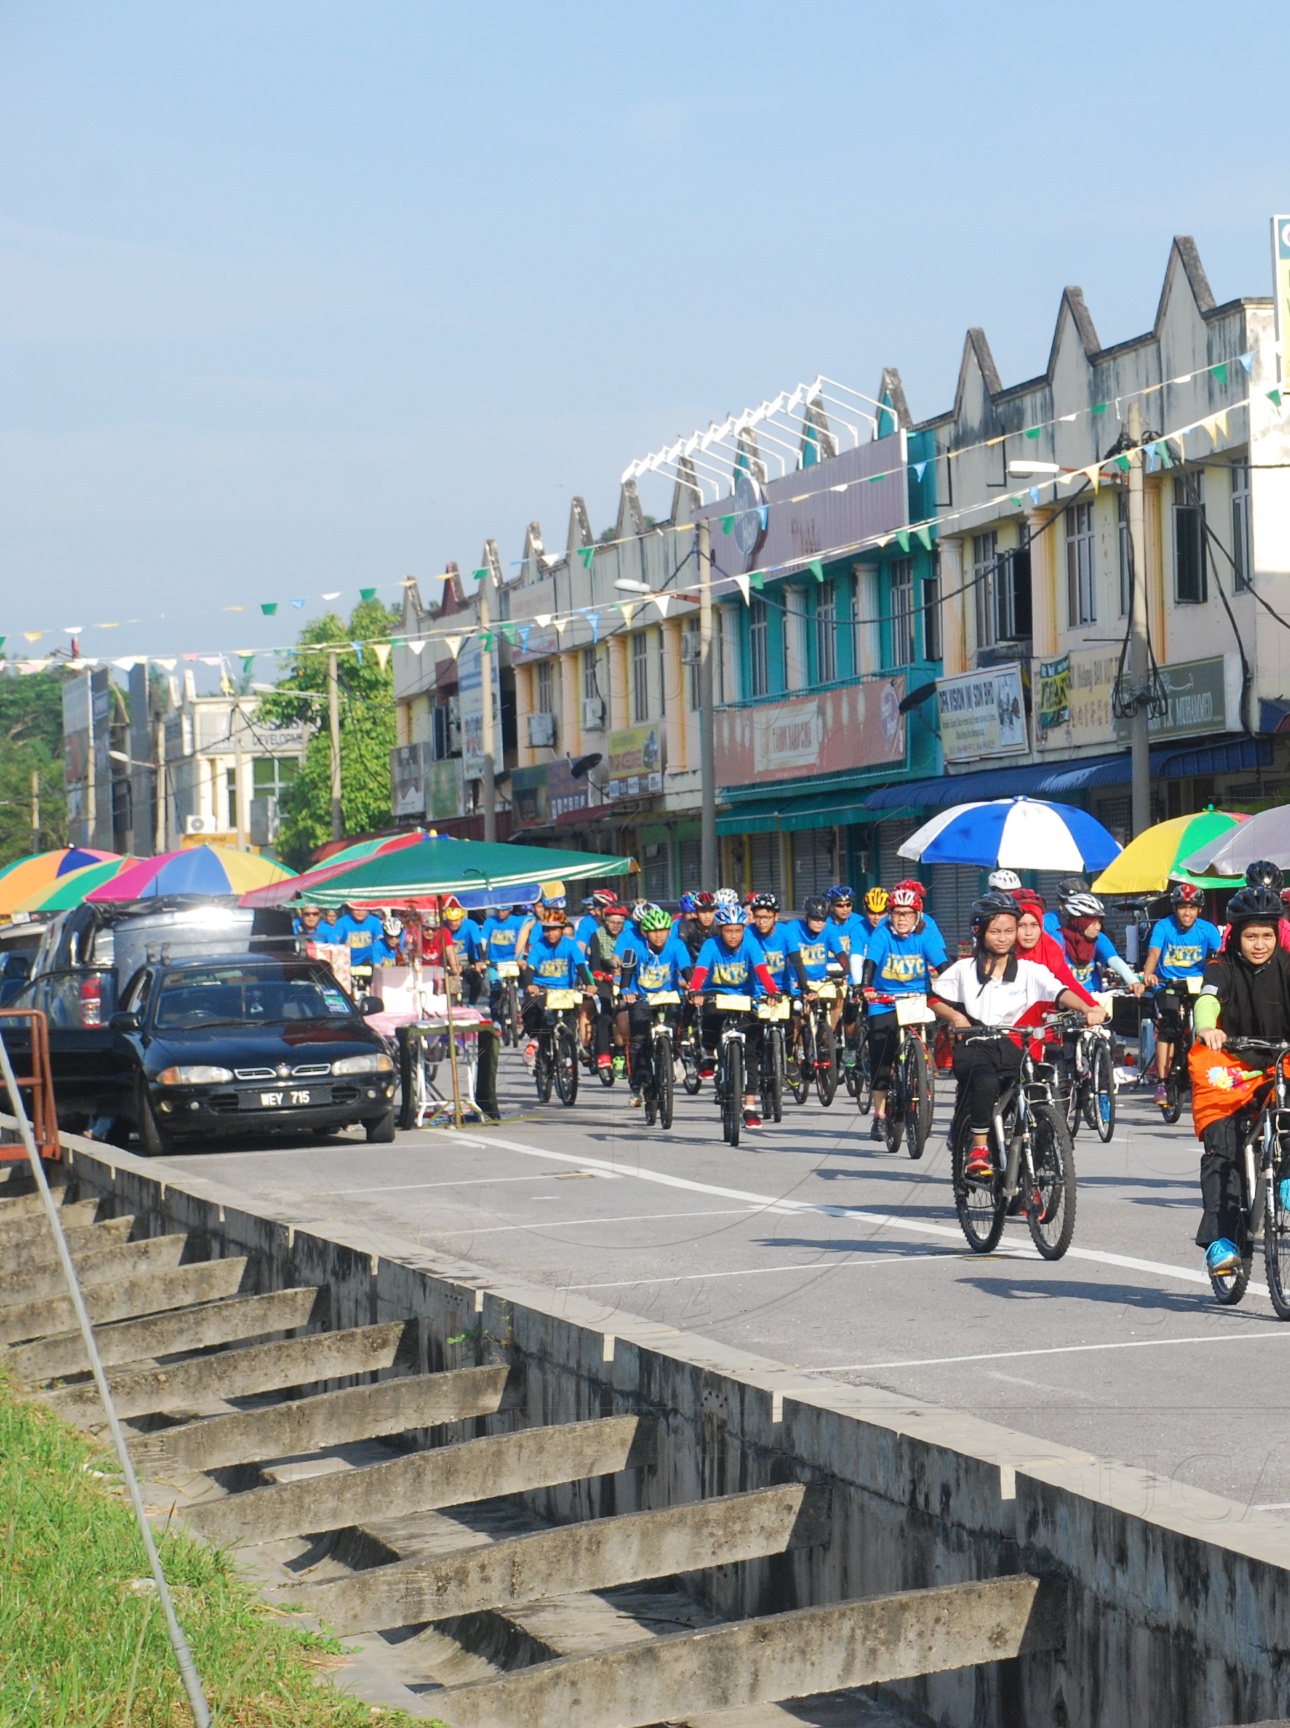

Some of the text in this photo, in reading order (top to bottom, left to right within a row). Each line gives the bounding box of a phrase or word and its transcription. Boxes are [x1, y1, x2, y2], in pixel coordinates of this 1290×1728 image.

[252, 733, 303, 746] DEVELOPME
[260, 1090, 310, 1106] WEY 715
